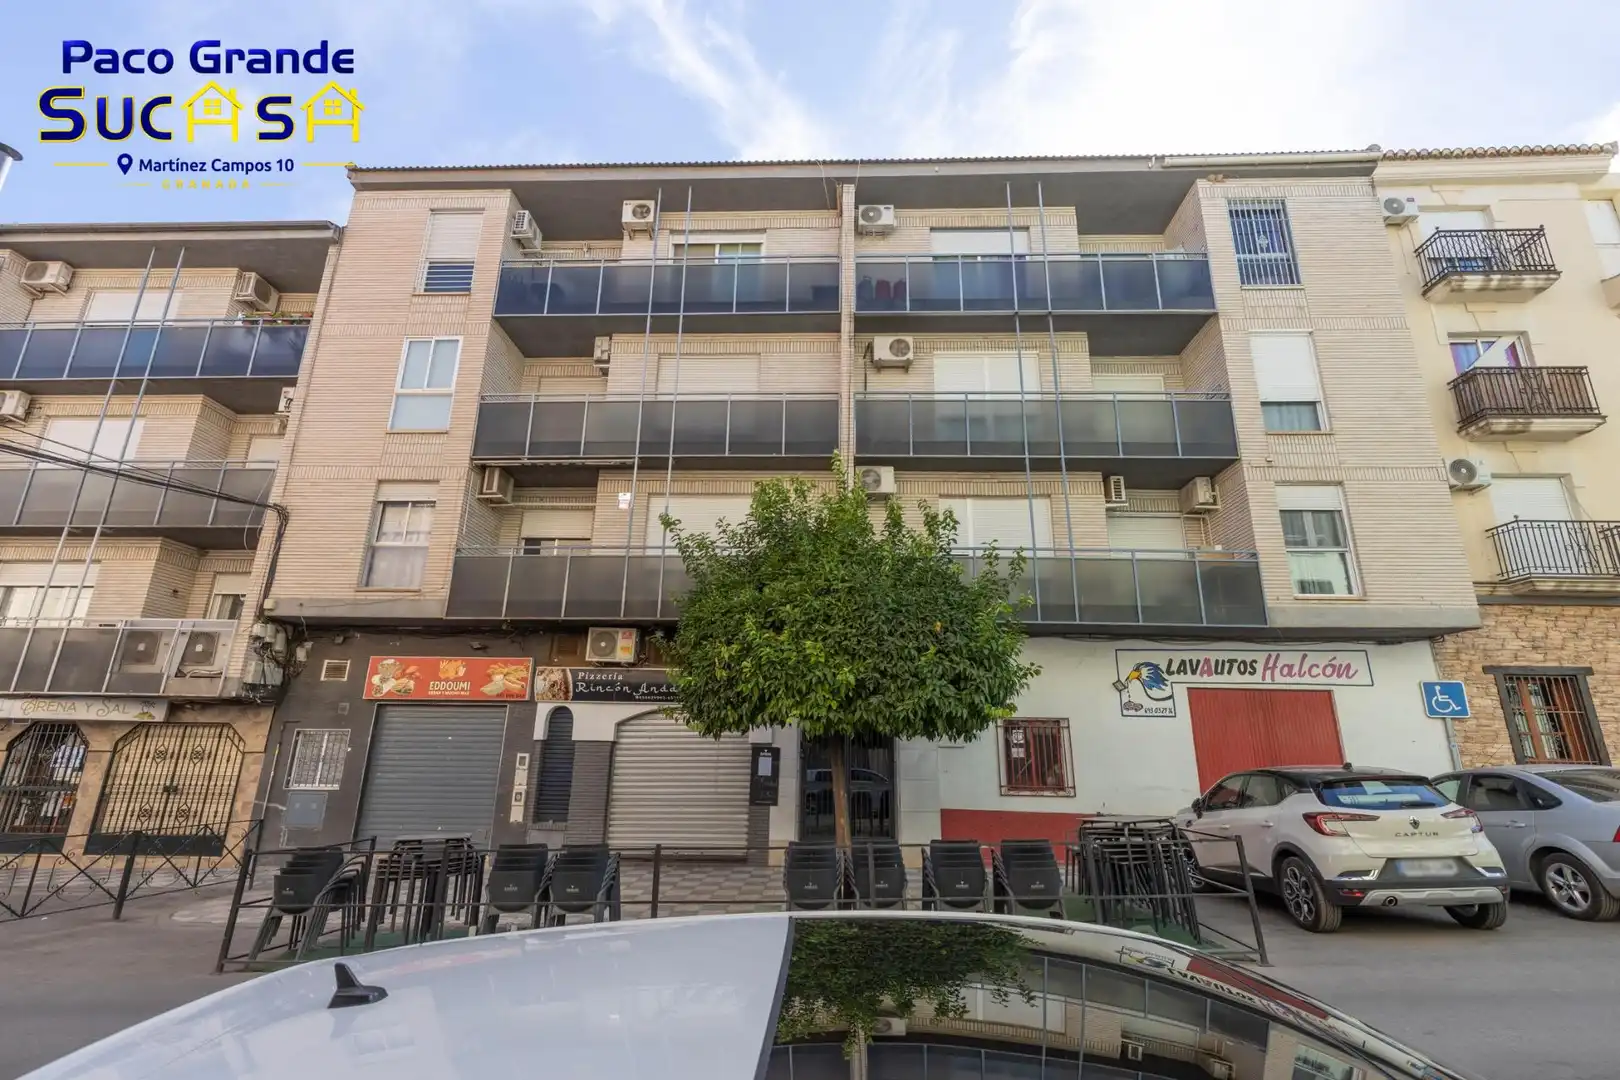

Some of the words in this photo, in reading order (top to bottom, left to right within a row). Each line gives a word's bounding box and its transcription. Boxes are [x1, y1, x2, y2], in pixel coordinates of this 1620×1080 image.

[1165, 657, 1258, 677] LAVAUTOS
[1261, 653, 1359, 681] Halcón
[429, 681, 471, 691] EDDOUMI
[575, 682, 632, 693] Rincón
[20, 698, 77, 716] ARENA
[85, 702, 94, 713] Y
